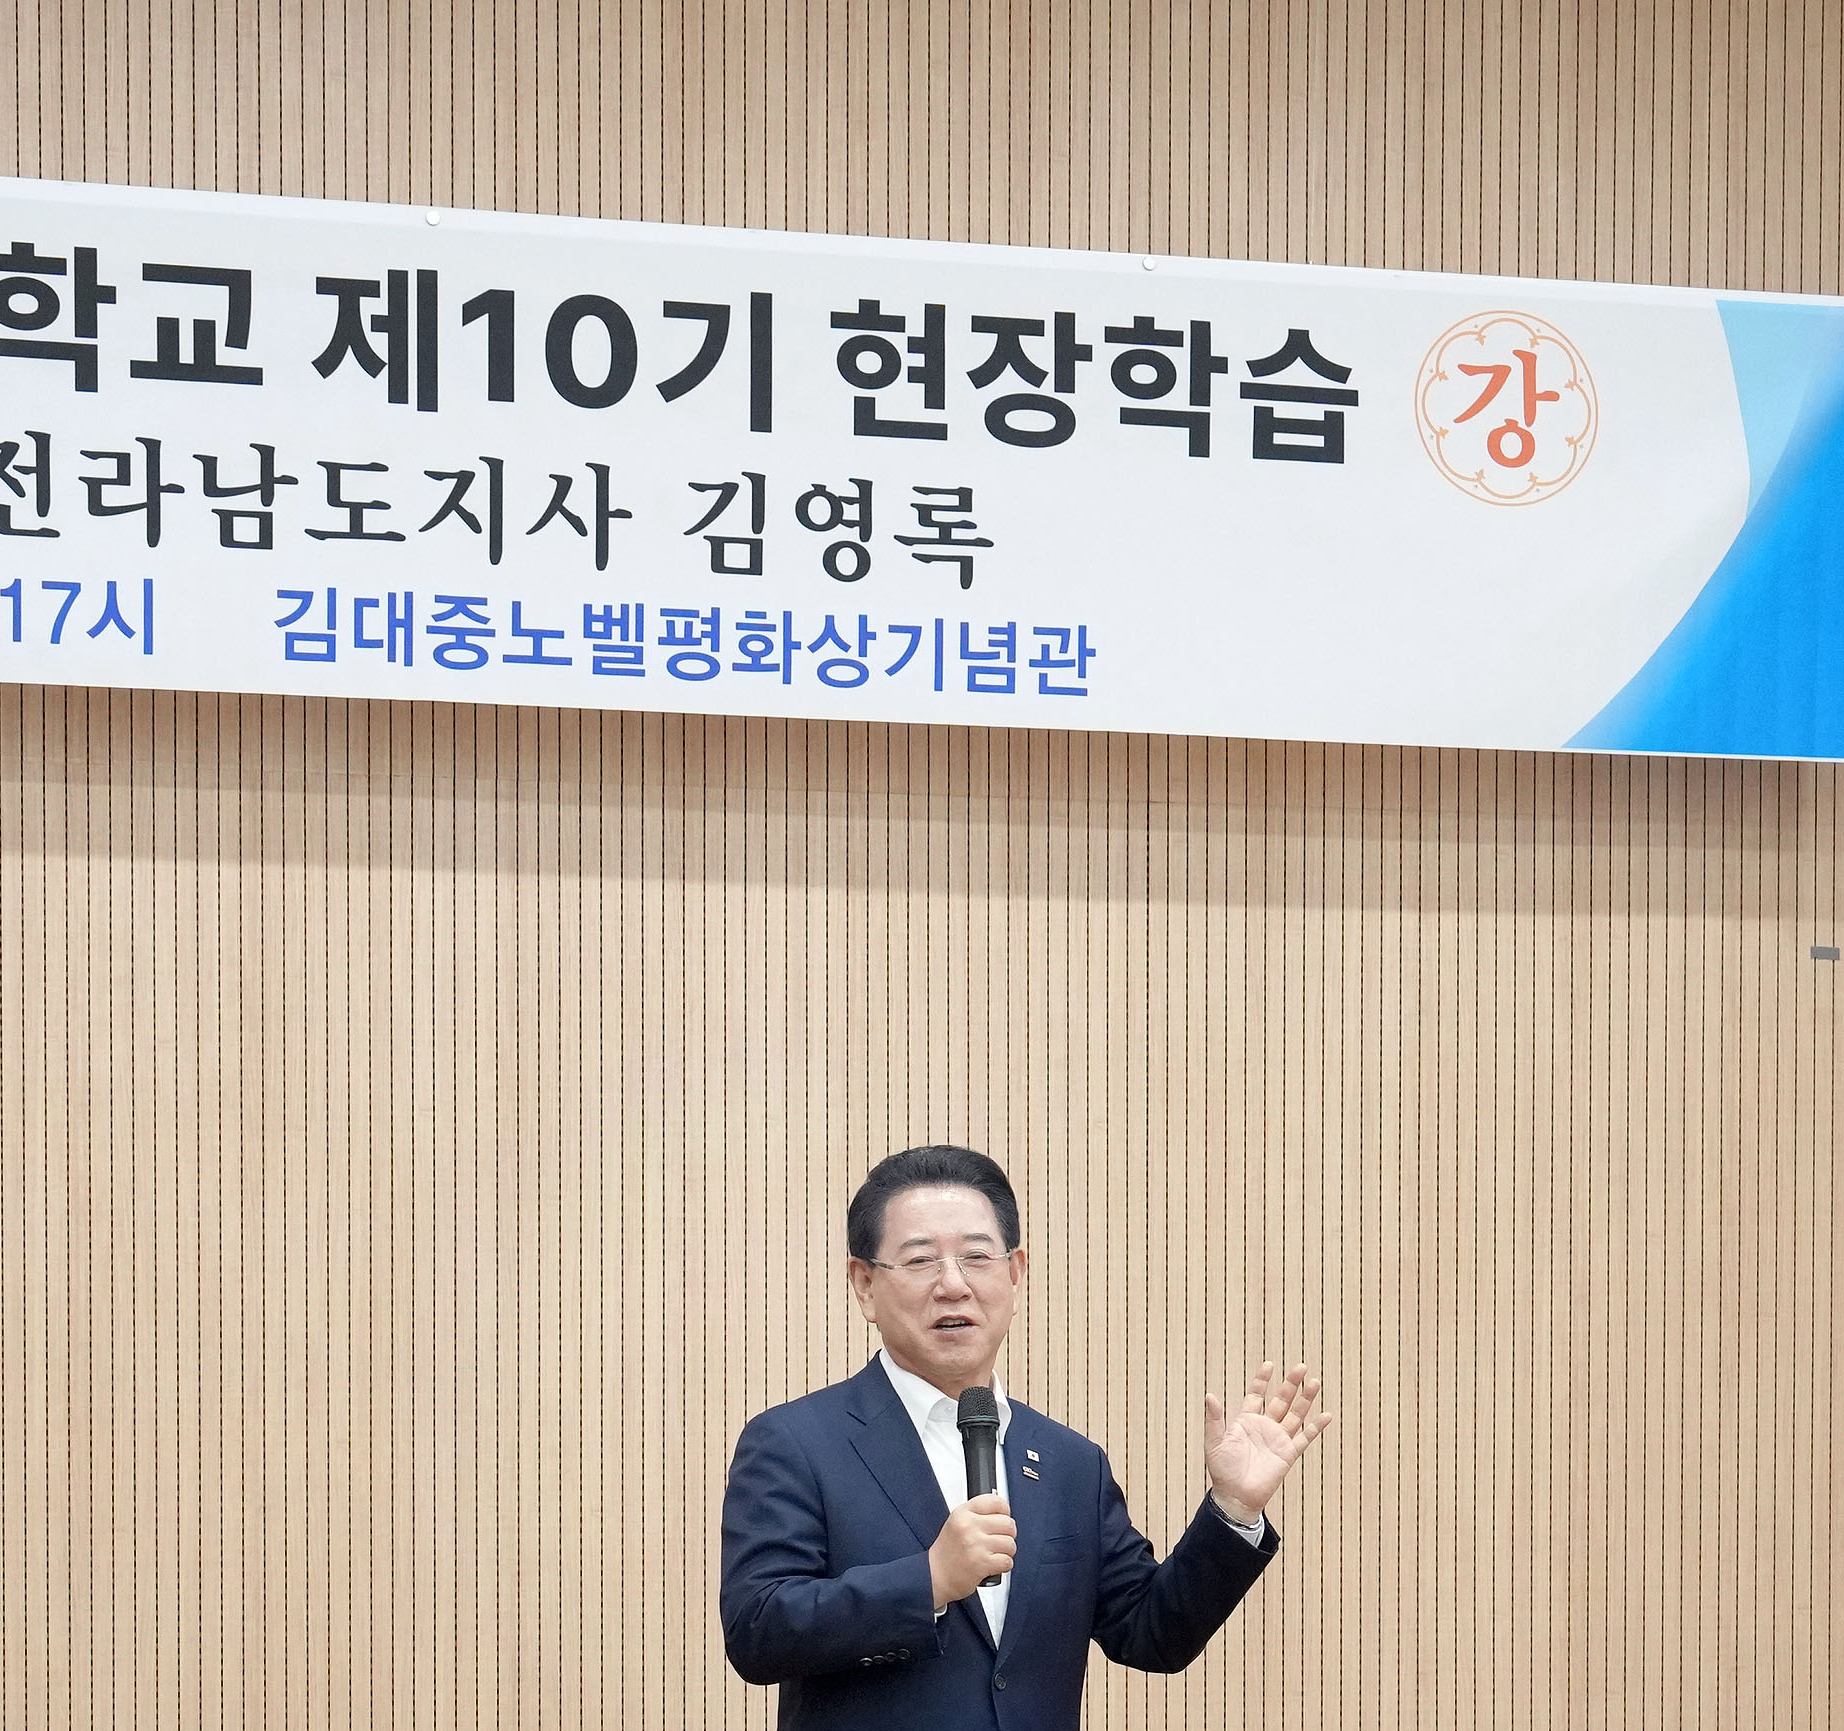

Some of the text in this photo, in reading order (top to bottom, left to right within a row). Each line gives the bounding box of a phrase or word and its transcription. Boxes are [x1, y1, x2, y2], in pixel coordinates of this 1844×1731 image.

[311, 268, 773, 435] 제10기
[830, 298, 1359, 466] 현장학습
[1454, 348, 1562, 469] 강
[683, 471, 995, 591] 김영록
[0, 578, 155, 656] 17시
[274, 587, 1098, 698] 김대중노벨평화상기념관
